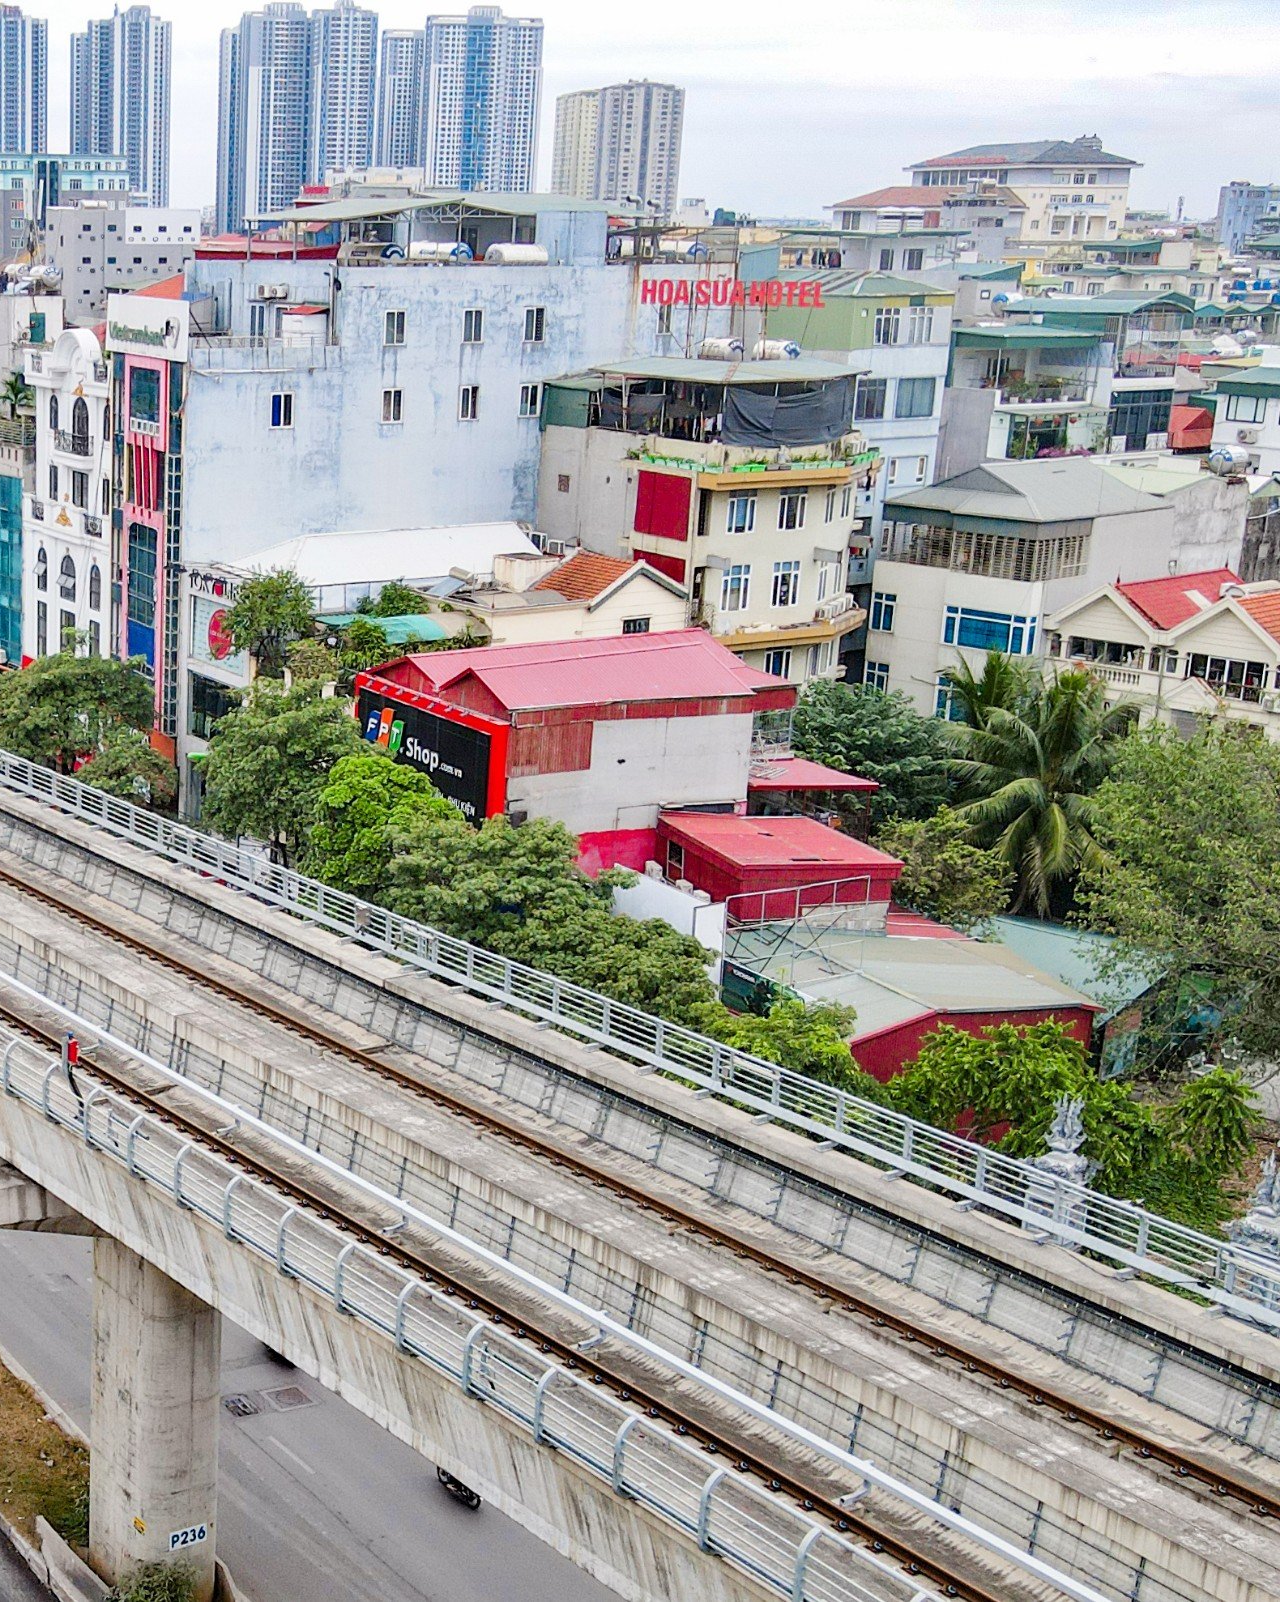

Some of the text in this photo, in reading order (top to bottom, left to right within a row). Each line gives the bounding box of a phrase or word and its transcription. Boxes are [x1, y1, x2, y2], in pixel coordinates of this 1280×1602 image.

[641, 273, 826, 309] HOA SỮA HOTEL
[366, 716, 402, 746] FPT
[405, 737, 439, 772] Shop
[171, 1525, 206, 1548] P236
